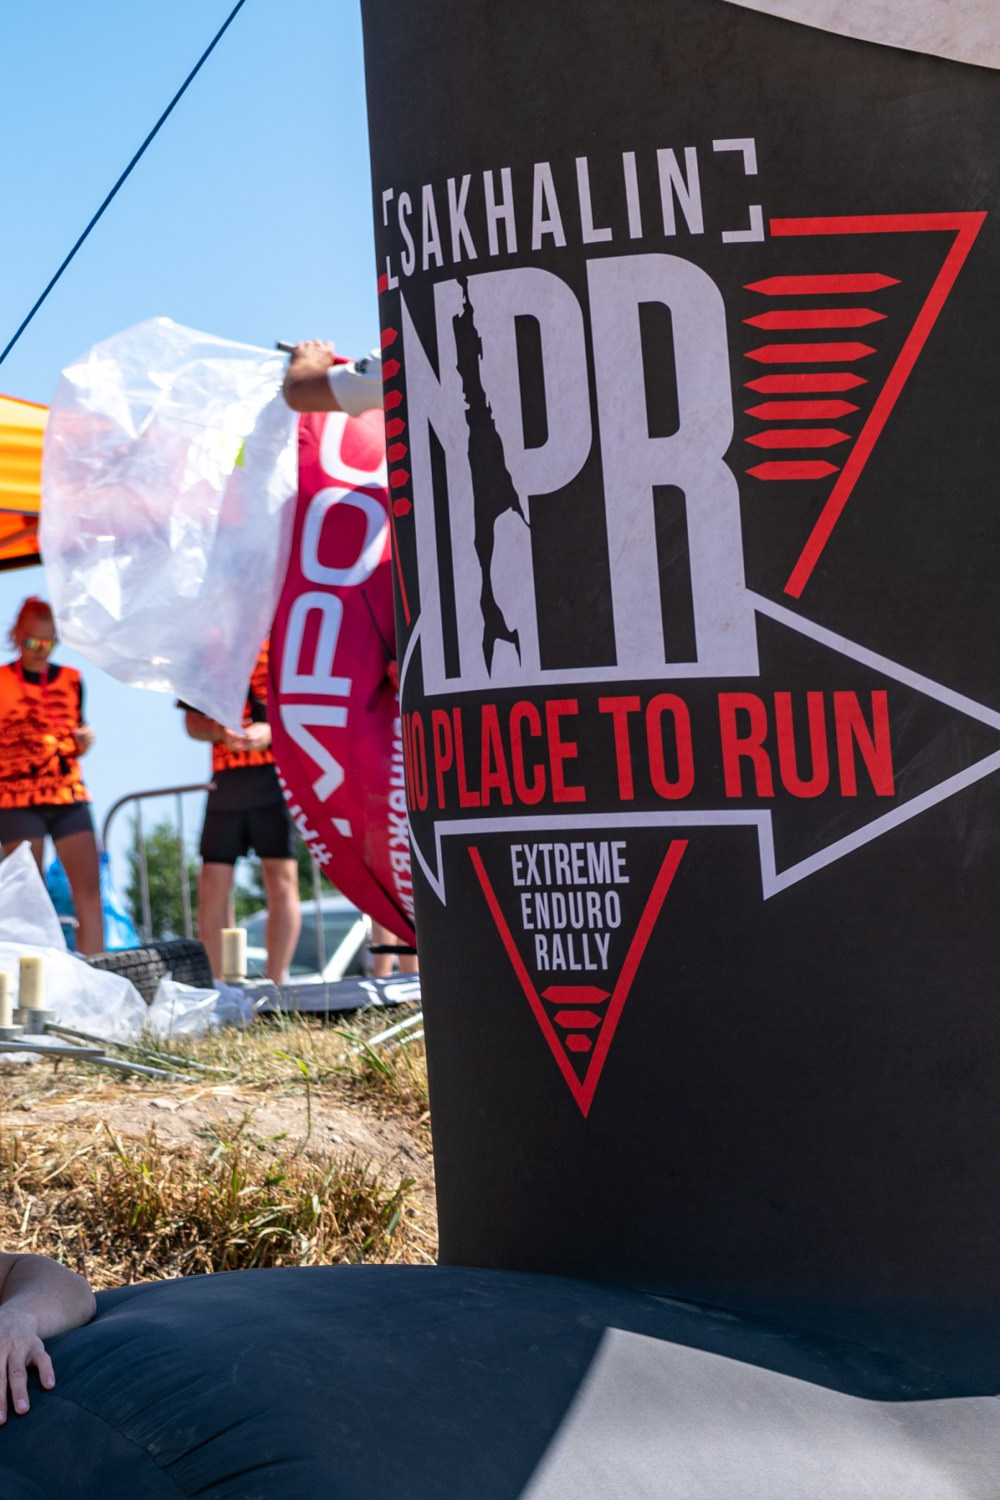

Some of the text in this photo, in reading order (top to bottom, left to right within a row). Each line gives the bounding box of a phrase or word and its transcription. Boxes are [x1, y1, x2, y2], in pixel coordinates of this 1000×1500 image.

[397, 146, 705, 278] SAKHALIN
[402, 689, 896, 812] NO PLACE TO RUN
[509, 840, 630, 887] EXTREME
[520, 890, 623, 931] ENDURO
[534, 932, 613, 972] RALLY
